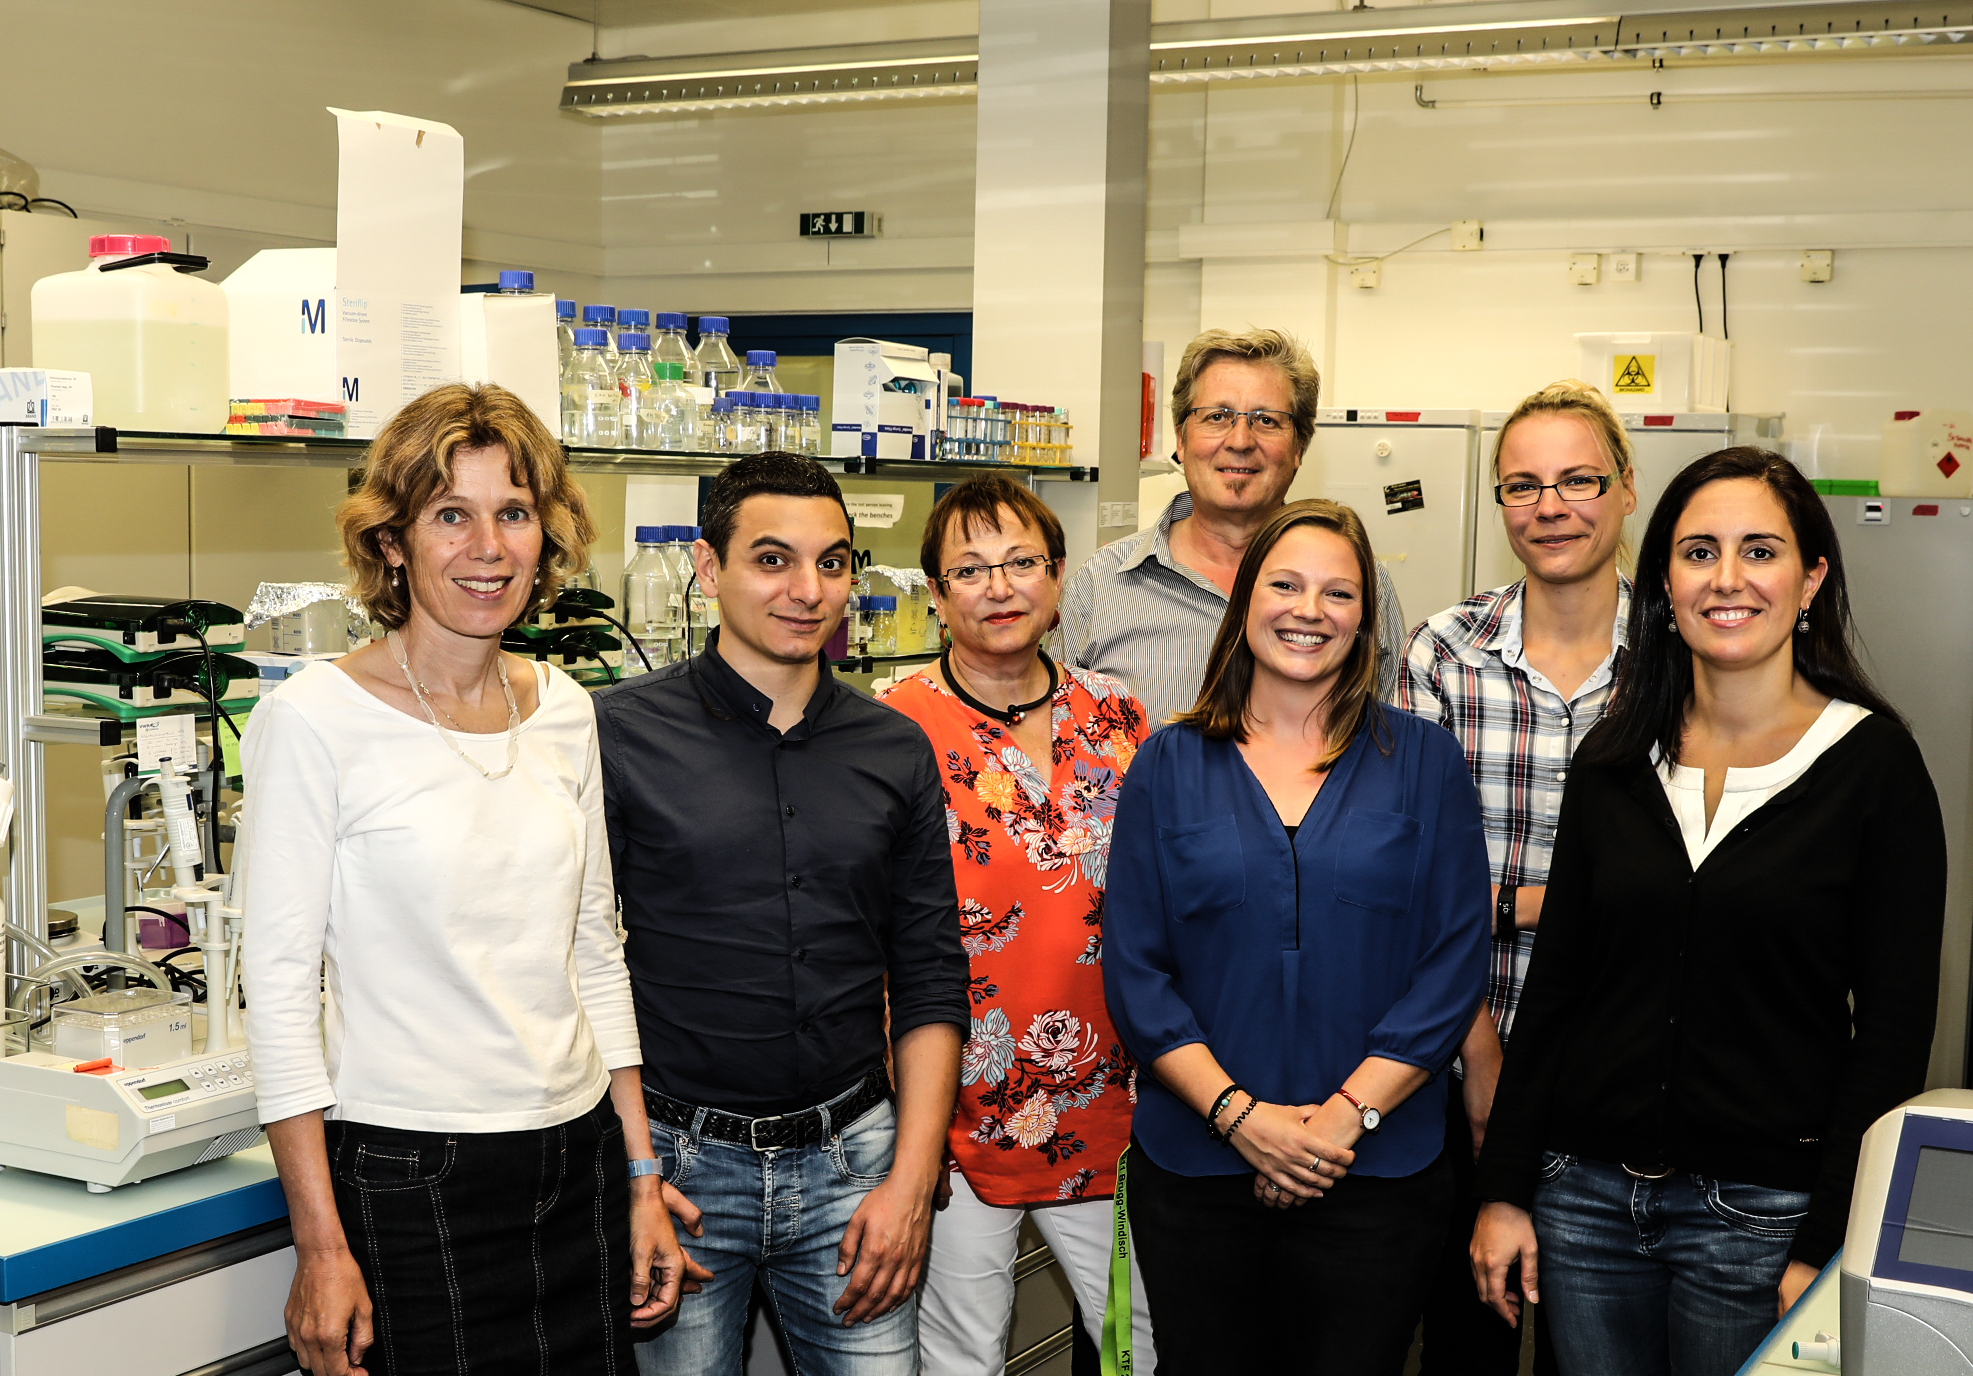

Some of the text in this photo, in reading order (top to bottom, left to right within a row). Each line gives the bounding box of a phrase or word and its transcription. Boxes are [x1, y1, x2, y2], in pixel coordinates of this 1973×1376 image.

[342, 297, 368, 310] Steriflip
[169, 1021, 180, 1032] 1.5
[123, 1033, 146, 1044] eppendorf
[123, 1077, 146, 1088] eppendorf
[1115, 1173, 1129, 1259] Brugg-Windisch
[1121, 1349, 1131, 1371] KTF
